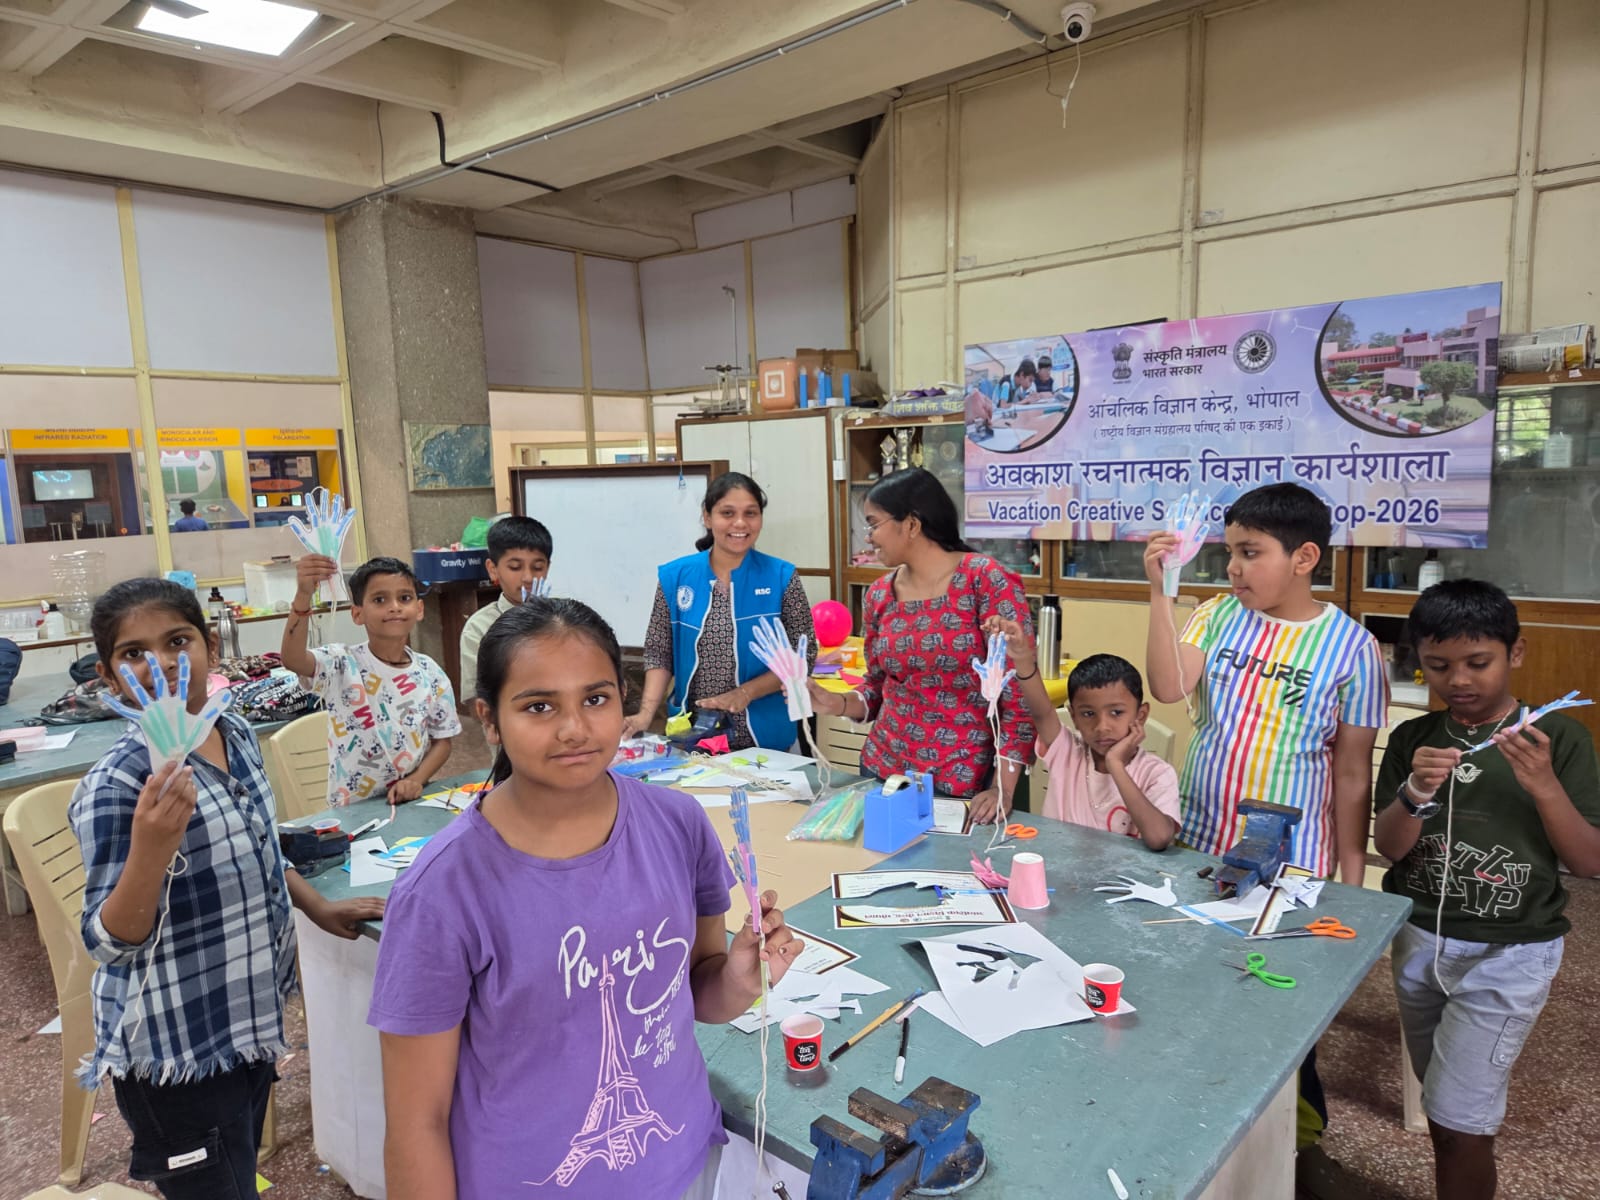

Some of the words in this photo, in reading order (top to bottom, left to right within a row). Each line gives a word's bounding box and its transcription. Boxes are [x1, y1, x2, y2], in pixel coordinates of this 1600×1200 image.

[1143, 346, 1183, 366] संस्कृति
[1185, 344, 1228, 360] मंत्रालय
[1142, 367, 1167, 380] भारत
[1169, 364, 1203, 378] सरकार
[1088, 397, 1149, 419] आंचलिक
[1153, 394, 1197, 417] विज्ञान
[1246, 387, 1301, 409] भोपाल
[1239, 420, 1256, 434] एक
[987, 461, 1073, 489] अवकाश
[1080, 459, 1192, 486] रचनात्मक
[1198, 448, 1286, 488] विज्ञान
[1291, 442, 1451, 484] कार्यशाला
[987, 500, 1060, 521] Vacation
[1066, 499, 1145, 521] Creative
[1328, 499, 1440, 529] op-2026
[440, 558, 466, 568] Gravity
[1215, 647, 1313, 688] FUTURE
[558, 916, 690, 1016] Paris
